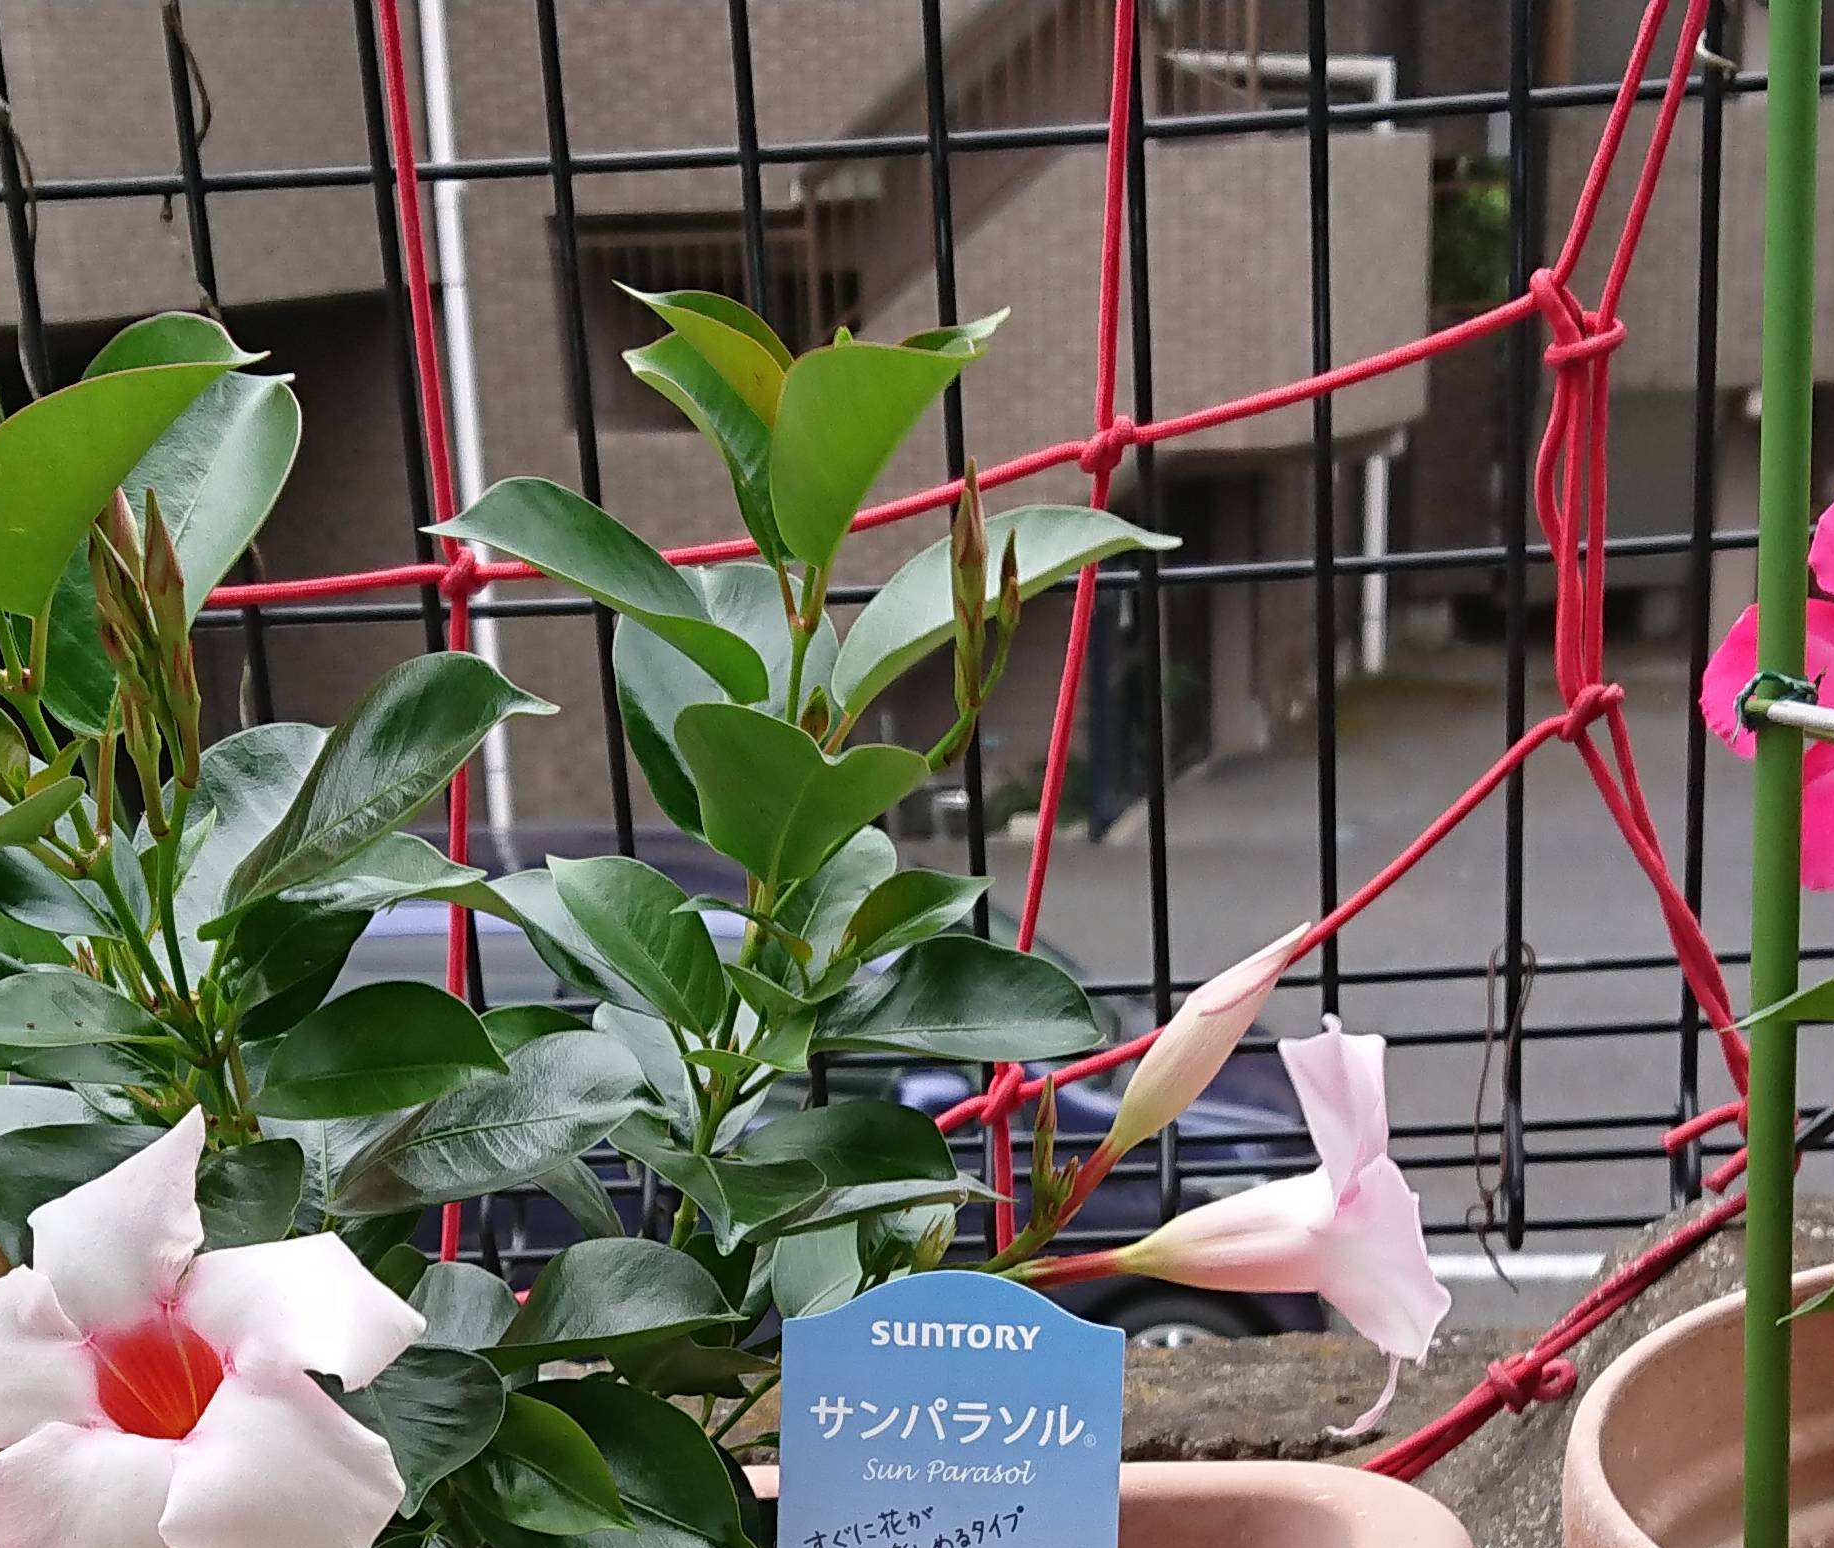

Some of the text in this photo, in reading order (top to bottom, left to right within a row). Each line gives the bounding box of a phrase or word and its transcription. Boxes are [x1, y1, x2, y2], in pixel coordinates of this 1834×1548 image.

[870, 1318, 1041, 1351] SUNTORY
[809, 1394, 1085, 1447] サンパラソル
[861, 1457, 1037, 1485] Sun Parasol
